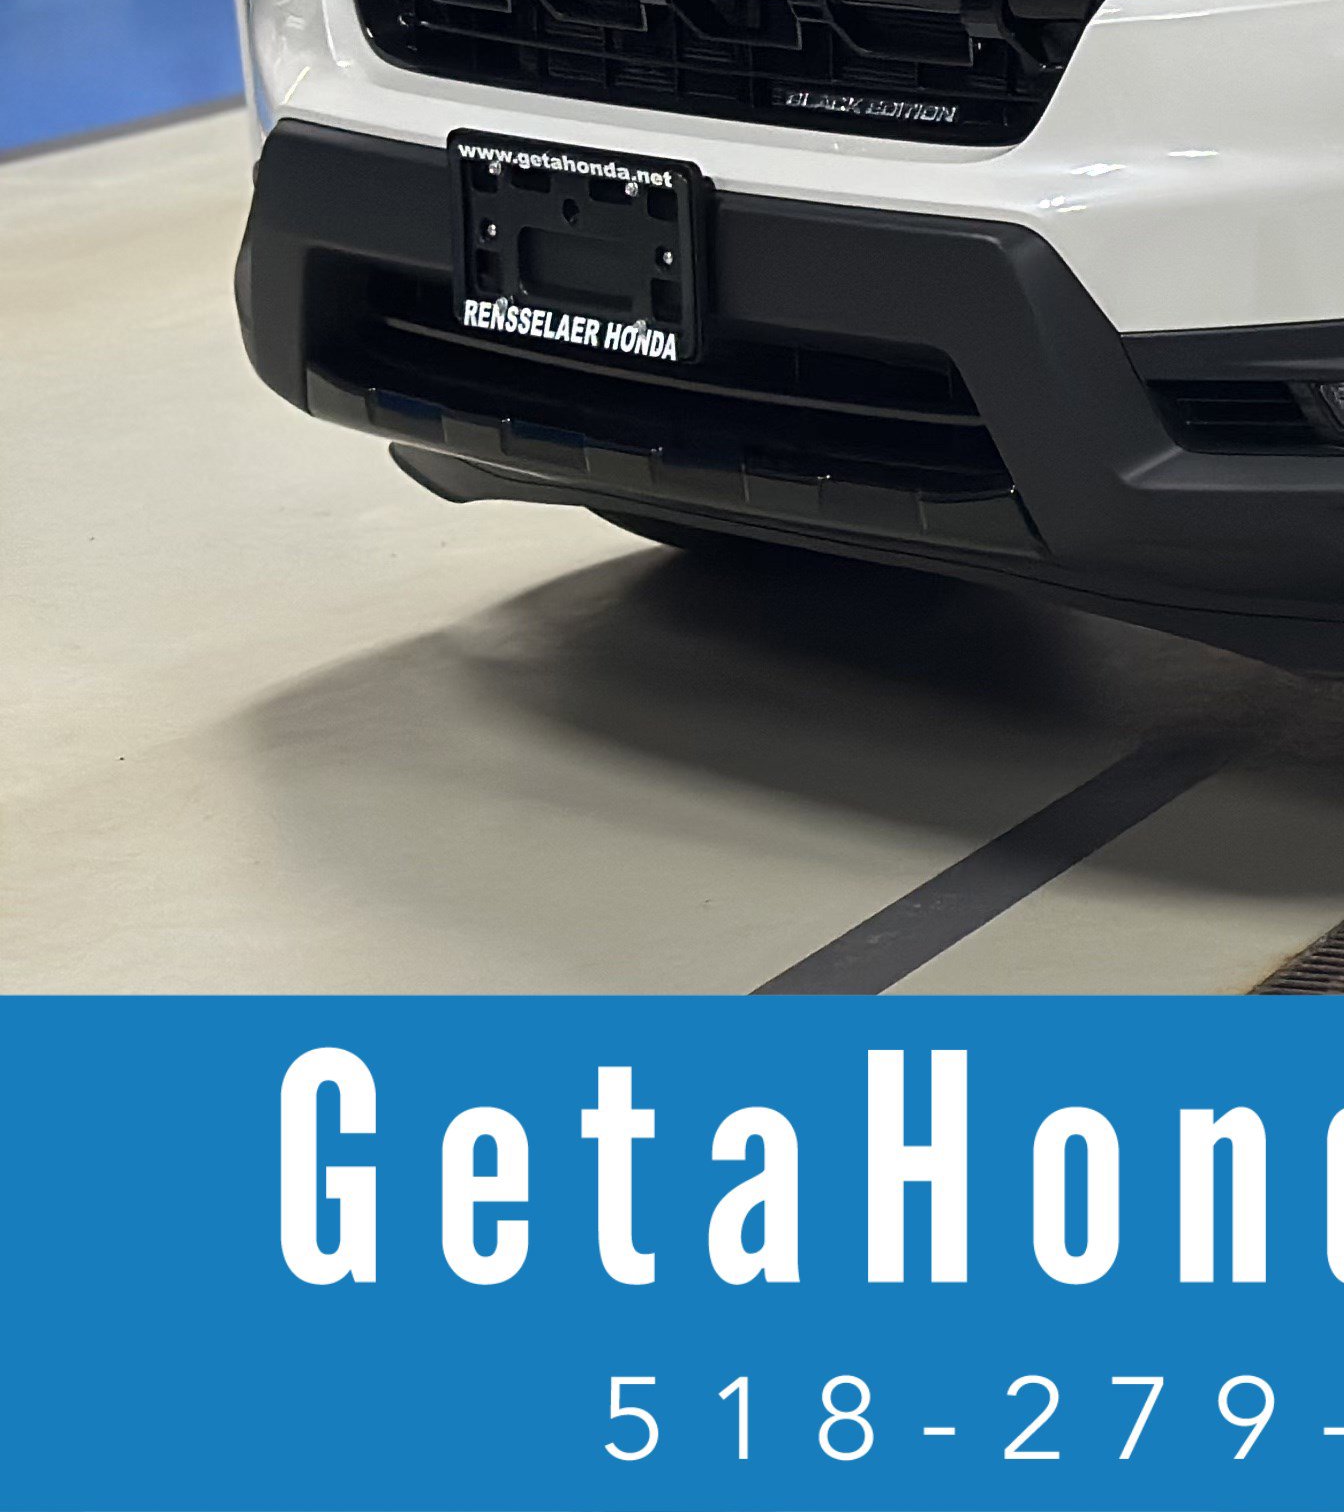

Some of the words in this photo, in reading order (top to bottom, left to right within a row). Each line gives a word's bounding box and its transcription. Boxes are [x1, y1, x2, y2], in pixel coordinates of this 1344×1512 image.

[785, 92, 863, 115] BLACK
[865, 100, 957, 123] EDITION
[457, 144, 673, 188] www.getahonda.net
[463, 299, 600, 347] RENSSELAER
[604, 321, 677, 361] HONDA
